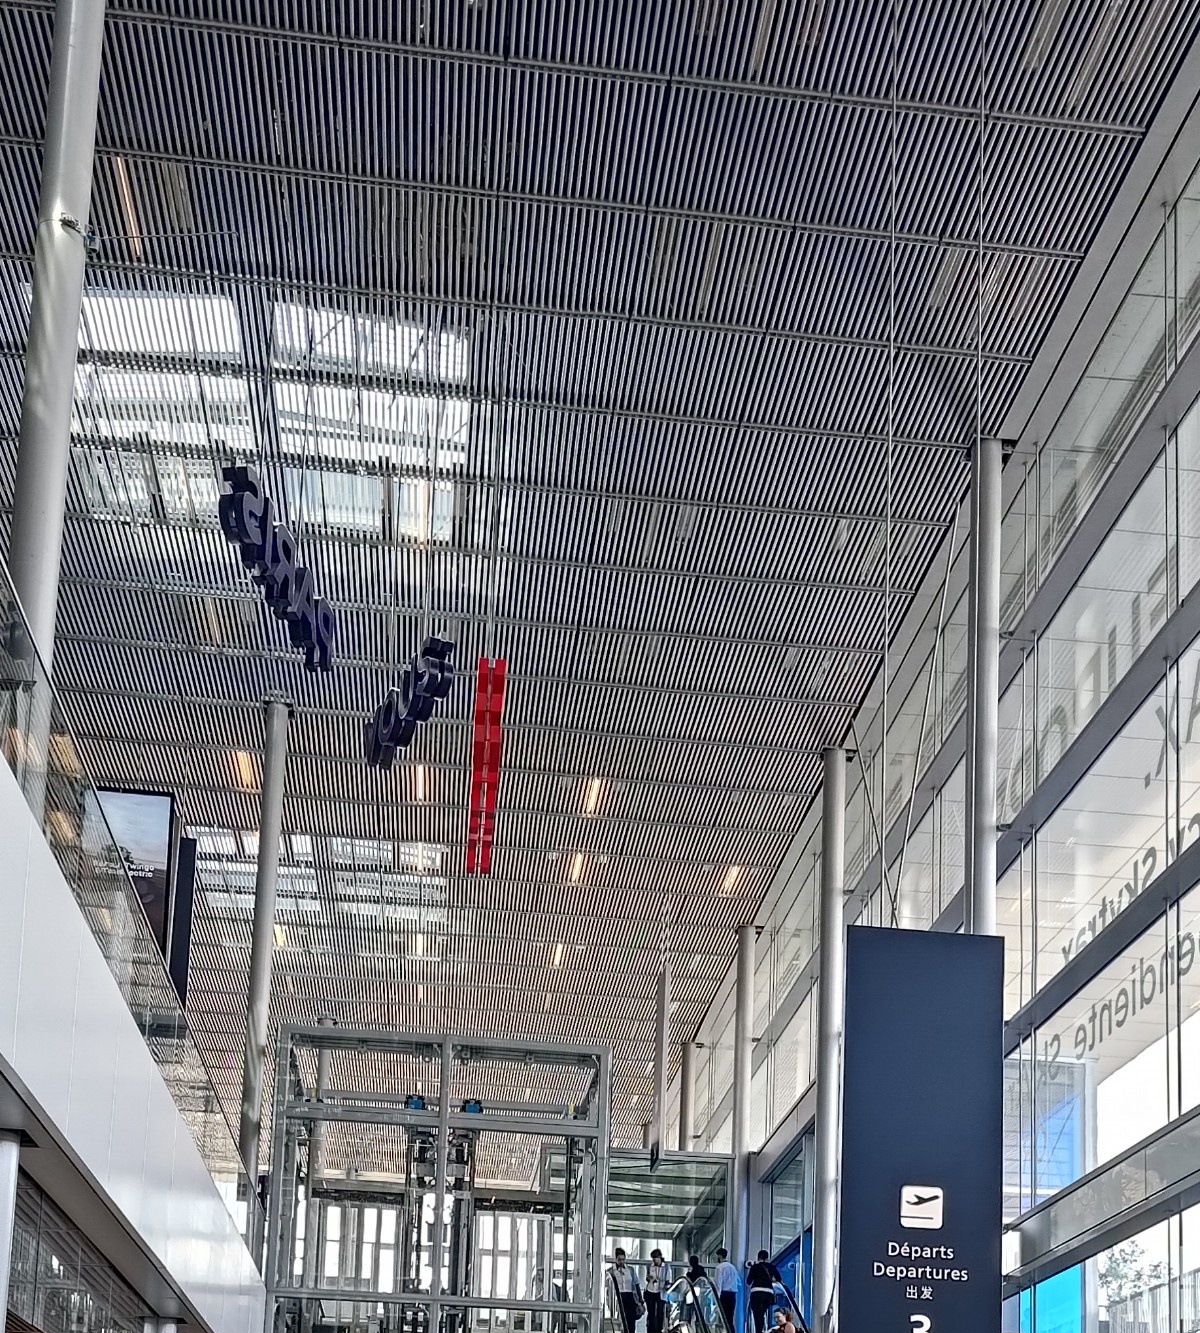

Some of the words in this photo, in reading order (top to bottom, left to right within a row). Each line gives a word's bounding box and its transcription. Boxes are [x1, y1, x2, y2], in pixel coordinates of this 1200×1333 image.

[888, 1241, 954, 1260] Départs
[873, 1261, 968, 1281] Departures
[906, 1285, 933, 1300] 出发
